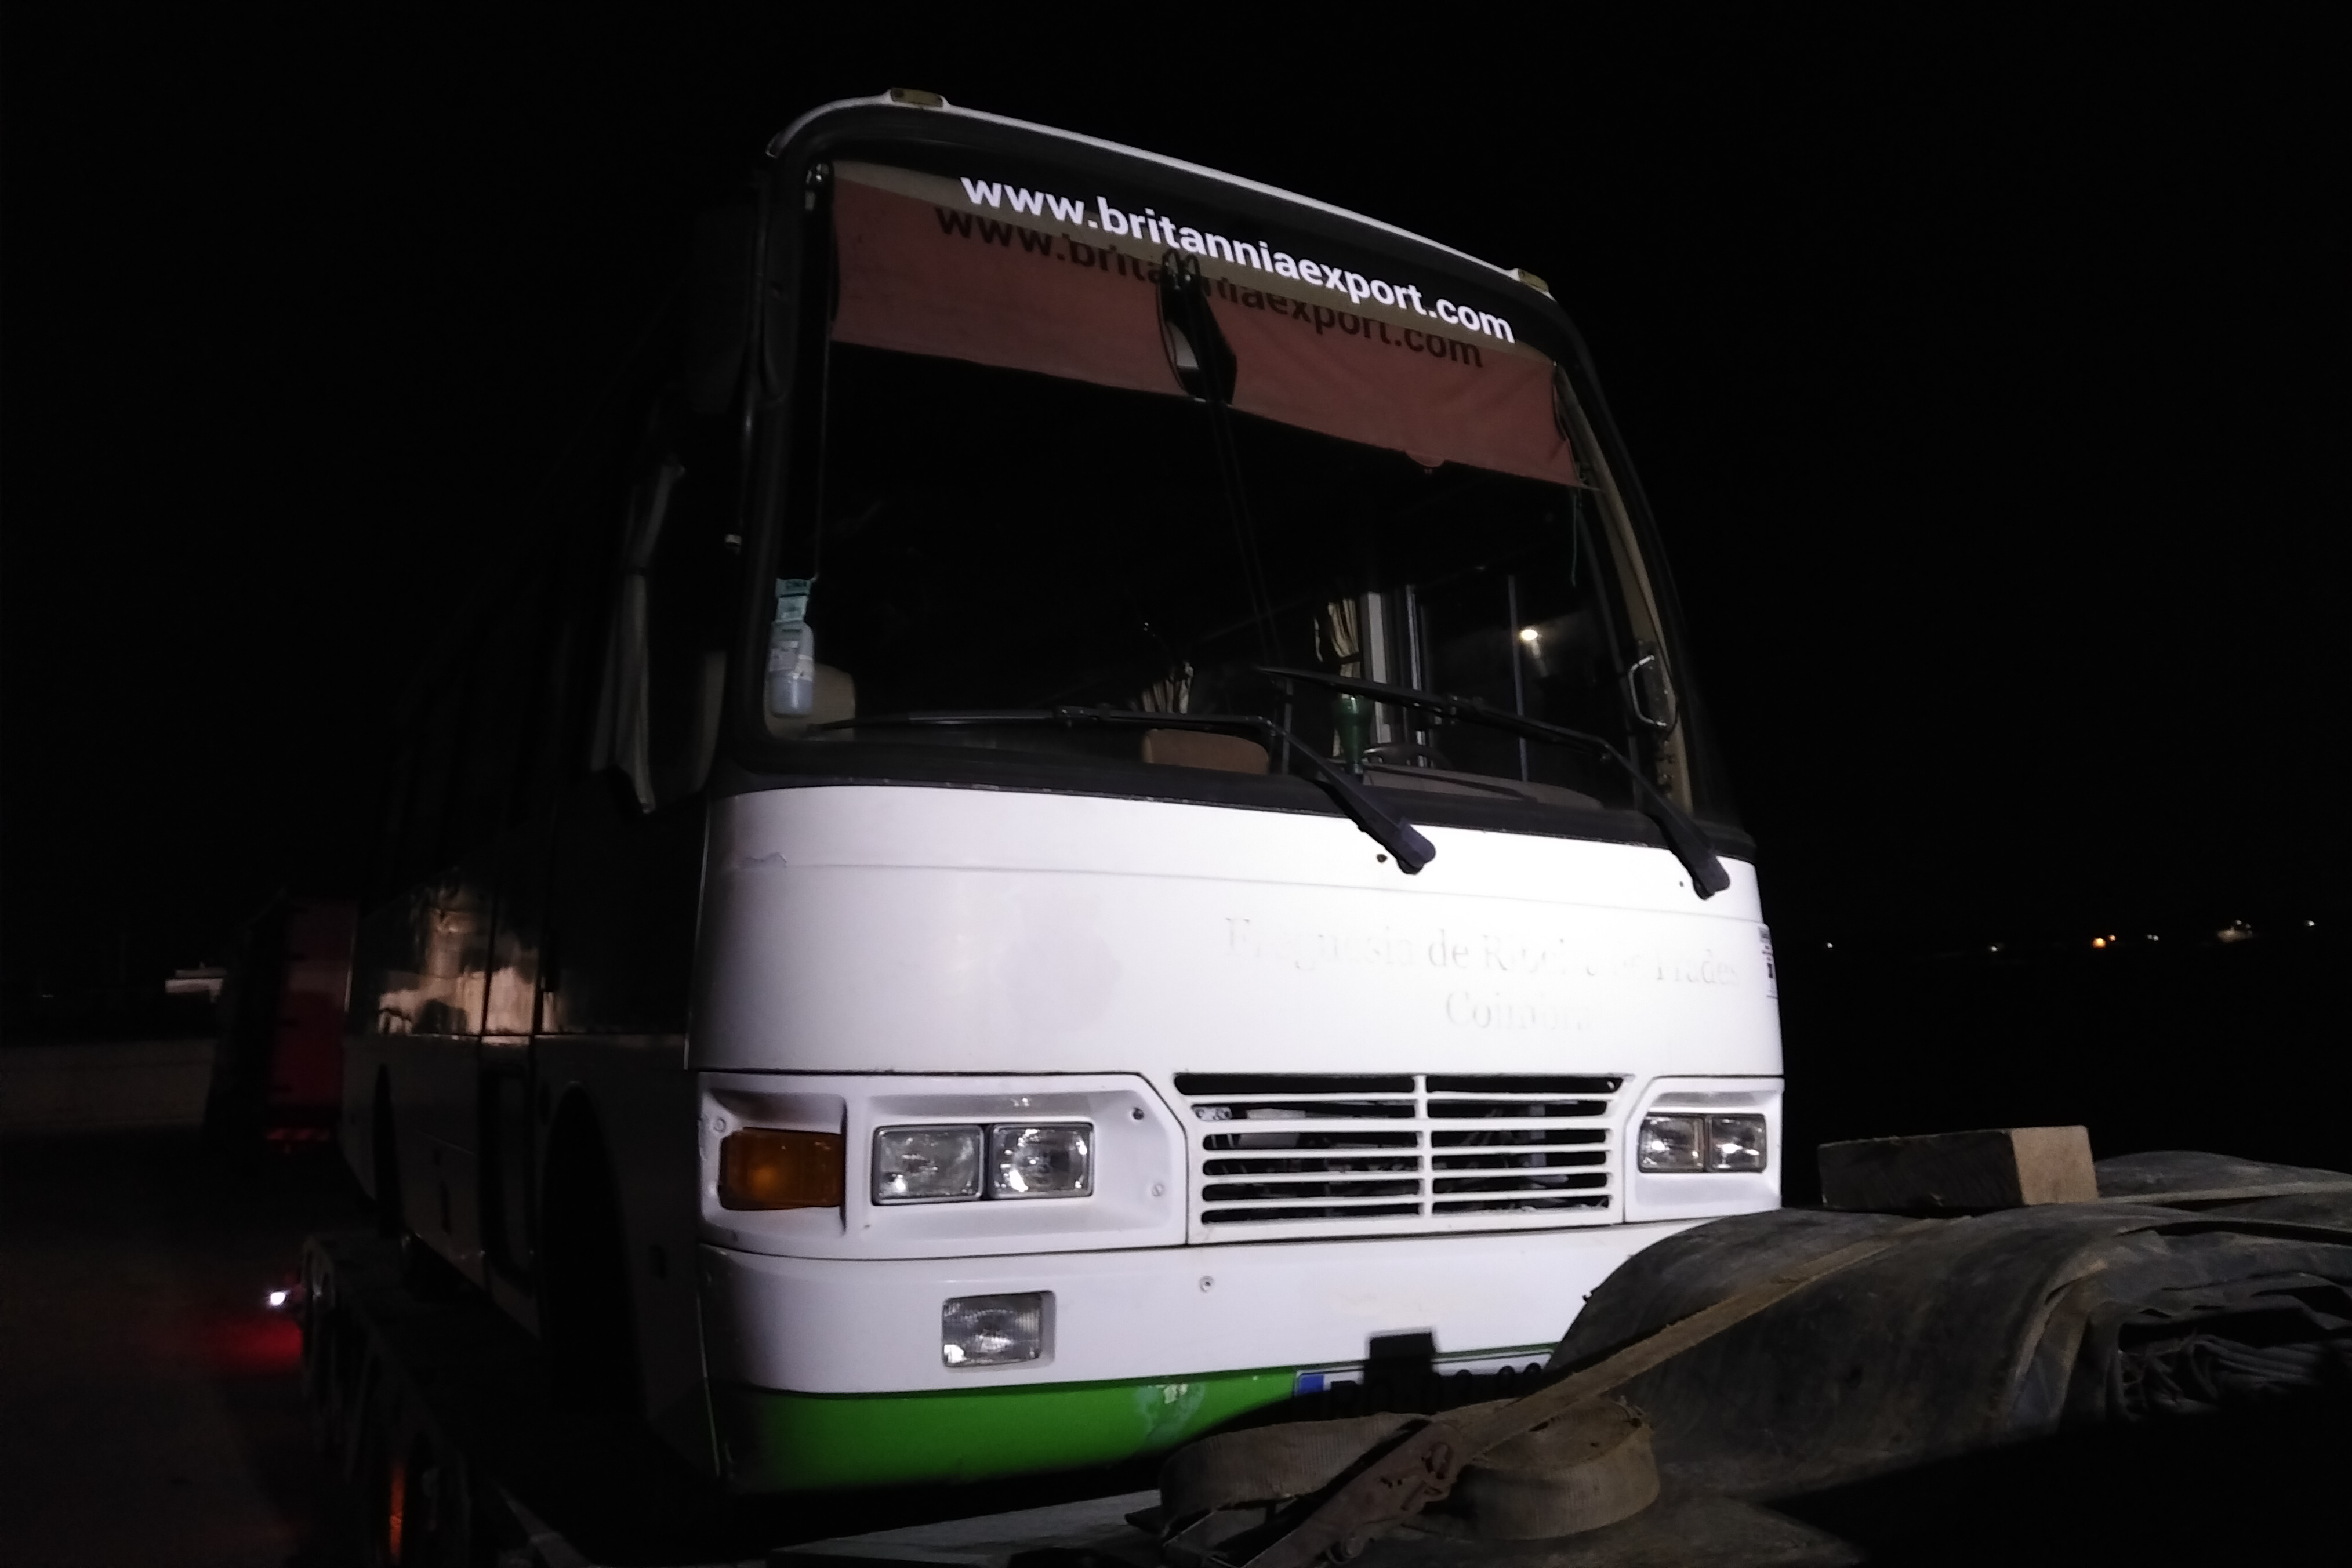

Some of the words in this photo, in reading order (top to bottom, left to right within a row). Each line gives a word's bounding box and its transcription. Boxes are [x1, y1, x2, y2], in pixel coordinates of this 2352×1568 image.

[935, 206, 1483, 368] www.britniaexport.com
[960, 176, 1516, 344] www.britanniaexport.com
[1428, 928, 1469, 969] de
